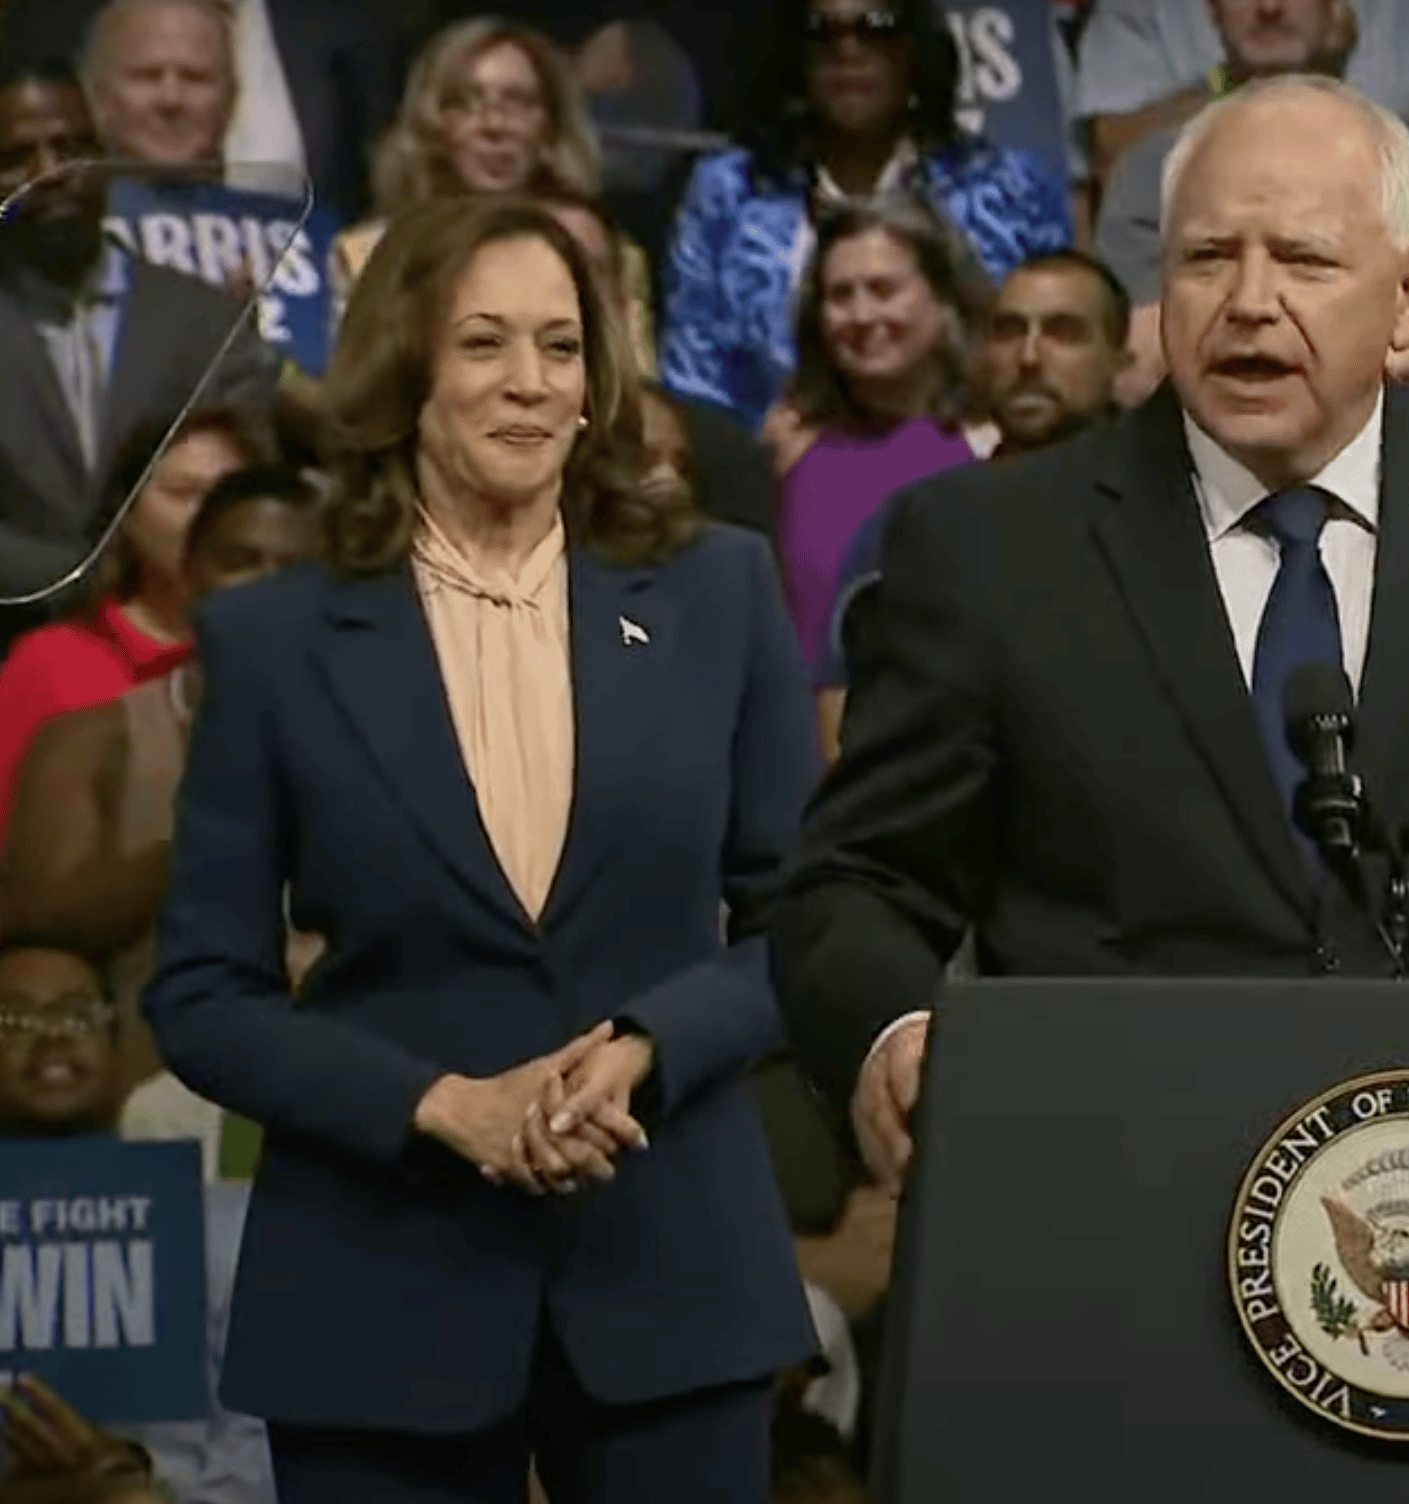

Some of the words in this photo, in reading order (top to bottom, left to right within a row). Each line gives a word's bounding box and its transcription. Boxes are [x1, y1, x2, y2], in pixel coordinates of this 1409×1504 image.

[1352, 1088, 1392, 1119] OF
[30, 1197, 151, 1233] FIGHT
[1238, 1106, 1334, 1322] PRESIDENT
[0, 1240, 154, 1349] WIN
[1270, 1332, 1351, 1420] VICE
